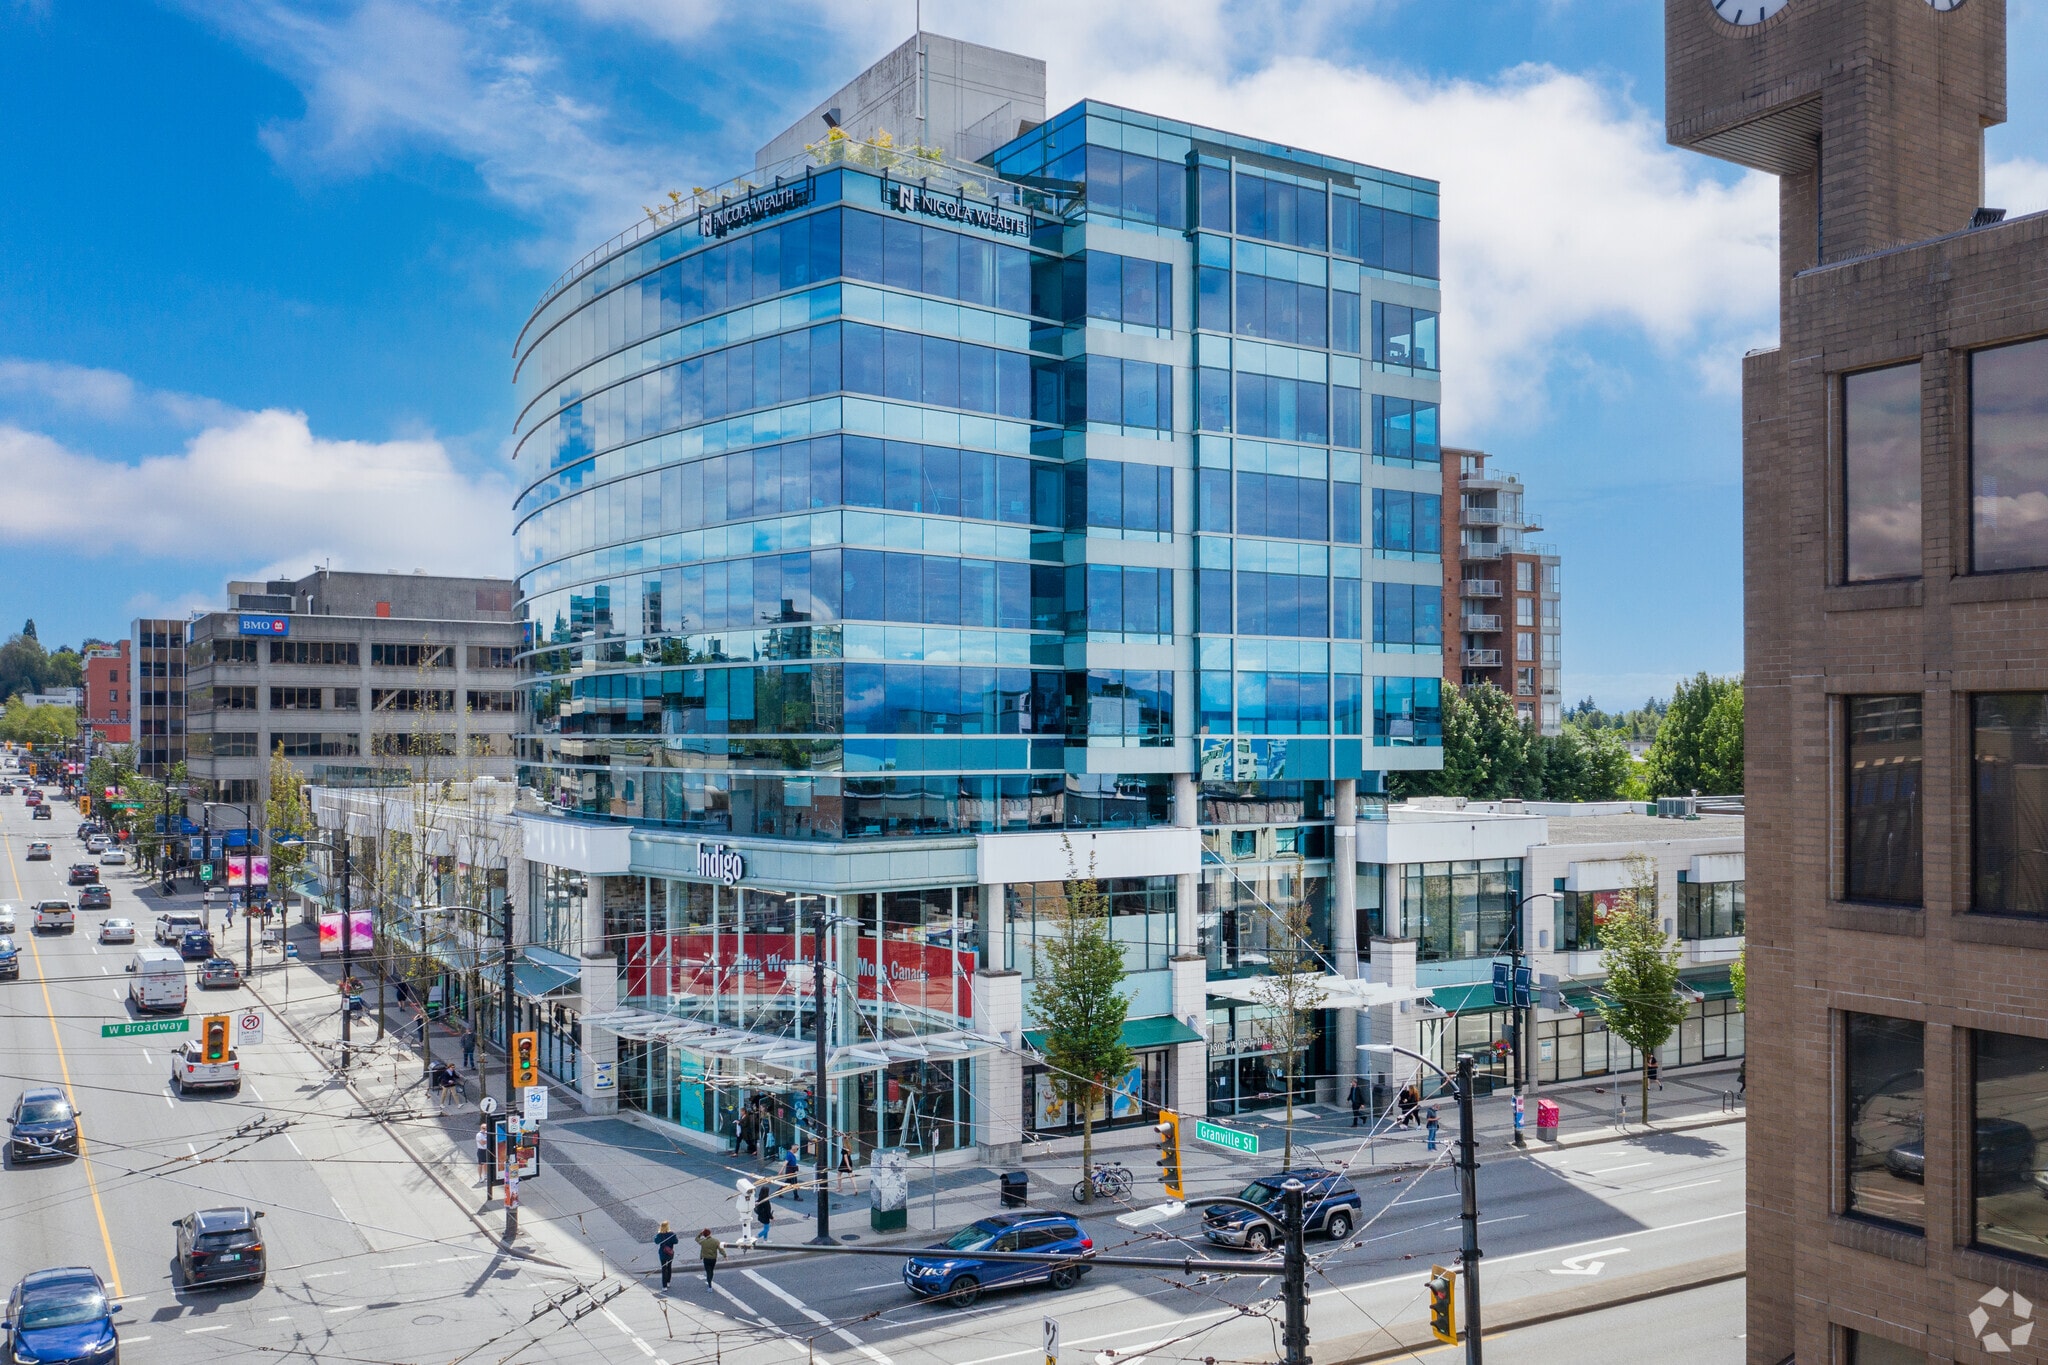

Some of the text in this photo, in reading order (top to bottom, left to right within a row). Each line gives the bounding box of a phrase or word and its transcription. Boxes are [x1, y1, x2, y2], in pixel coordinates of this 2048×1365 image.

[716, 203, 751, 228] NICOLA
[753, 188, 794, 213] WEALTH
[922, 195, 972, 221] NICOLA
[976, 208, 1027, 233] WEALTH
[243, 620, 270, 630] BMO
[202, 865, 211, 875] P
[697, 842, 742, 885] Indigo
[766, 953, 808, 972] Word
[856, 957, 888, 977] Moe
[891, 960, 924, 981] Canad
[109, 1022, 182, 1034] W Broadway
[530, 1094, 541, 1103] 99
[1201, 1125, 1252, 1151] Granville St
